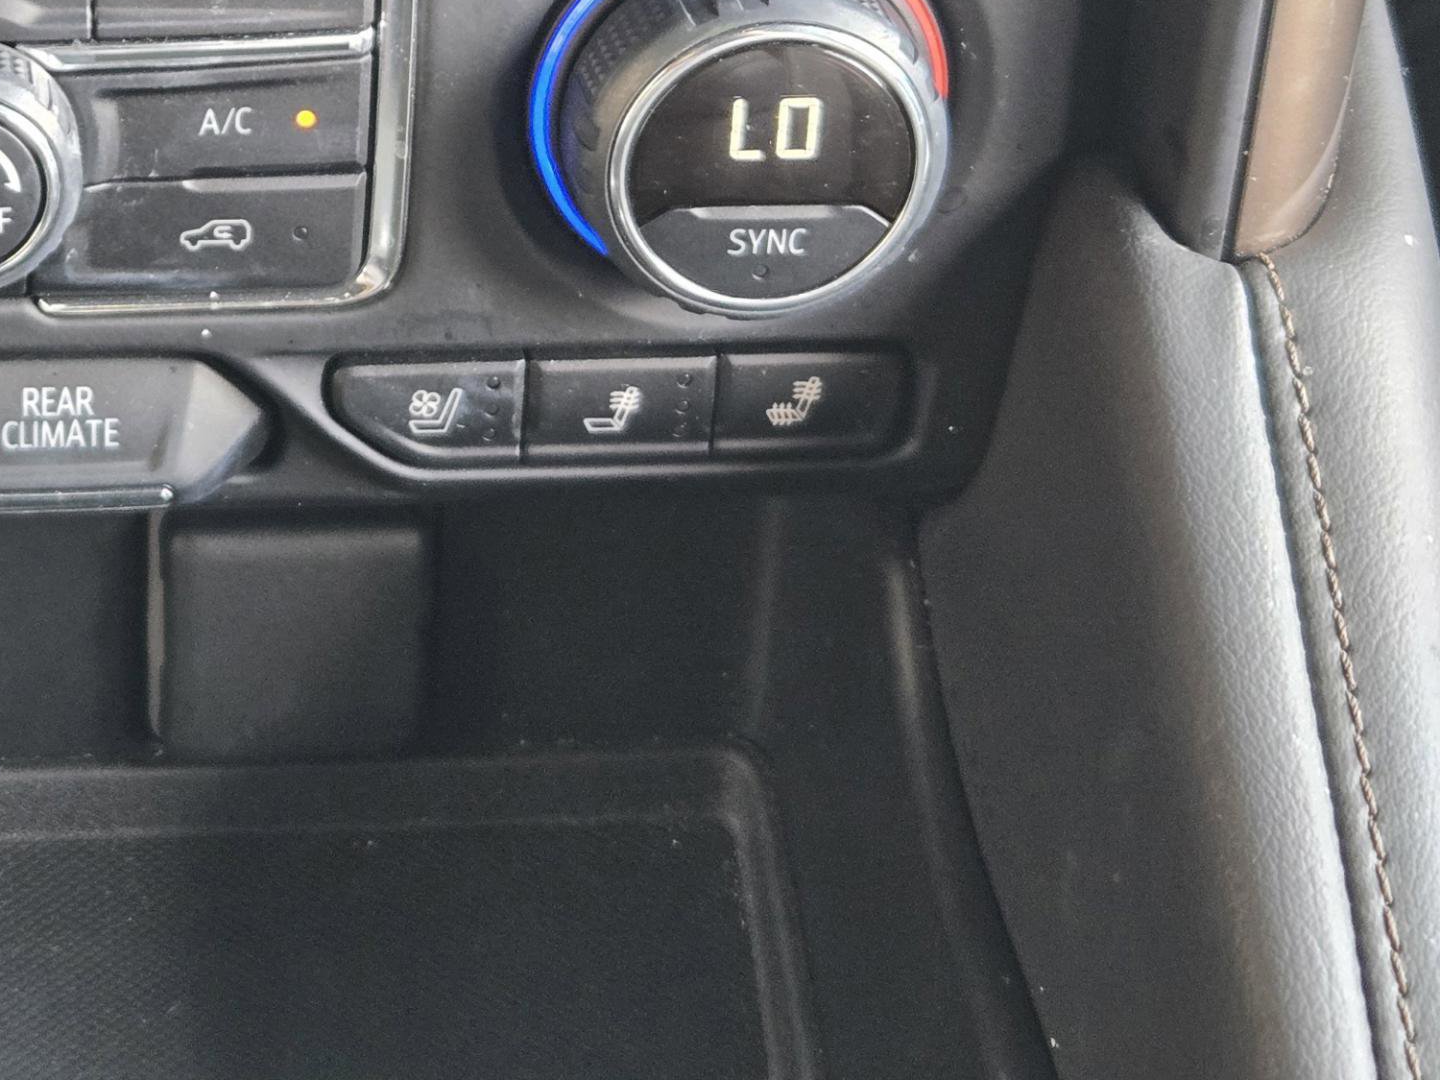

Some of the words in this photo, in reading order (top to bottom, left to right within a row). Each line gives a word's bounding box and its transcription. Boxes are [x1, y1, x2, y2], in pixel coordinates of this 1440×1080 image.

[198, 107, 253, 137] A/C
[729, 97, 823, 160] LO
[727, 228, 808, 257] SYNC
[22, 386, 95, 416] REAR
[2, 419, 120, 451] CLIMATE
